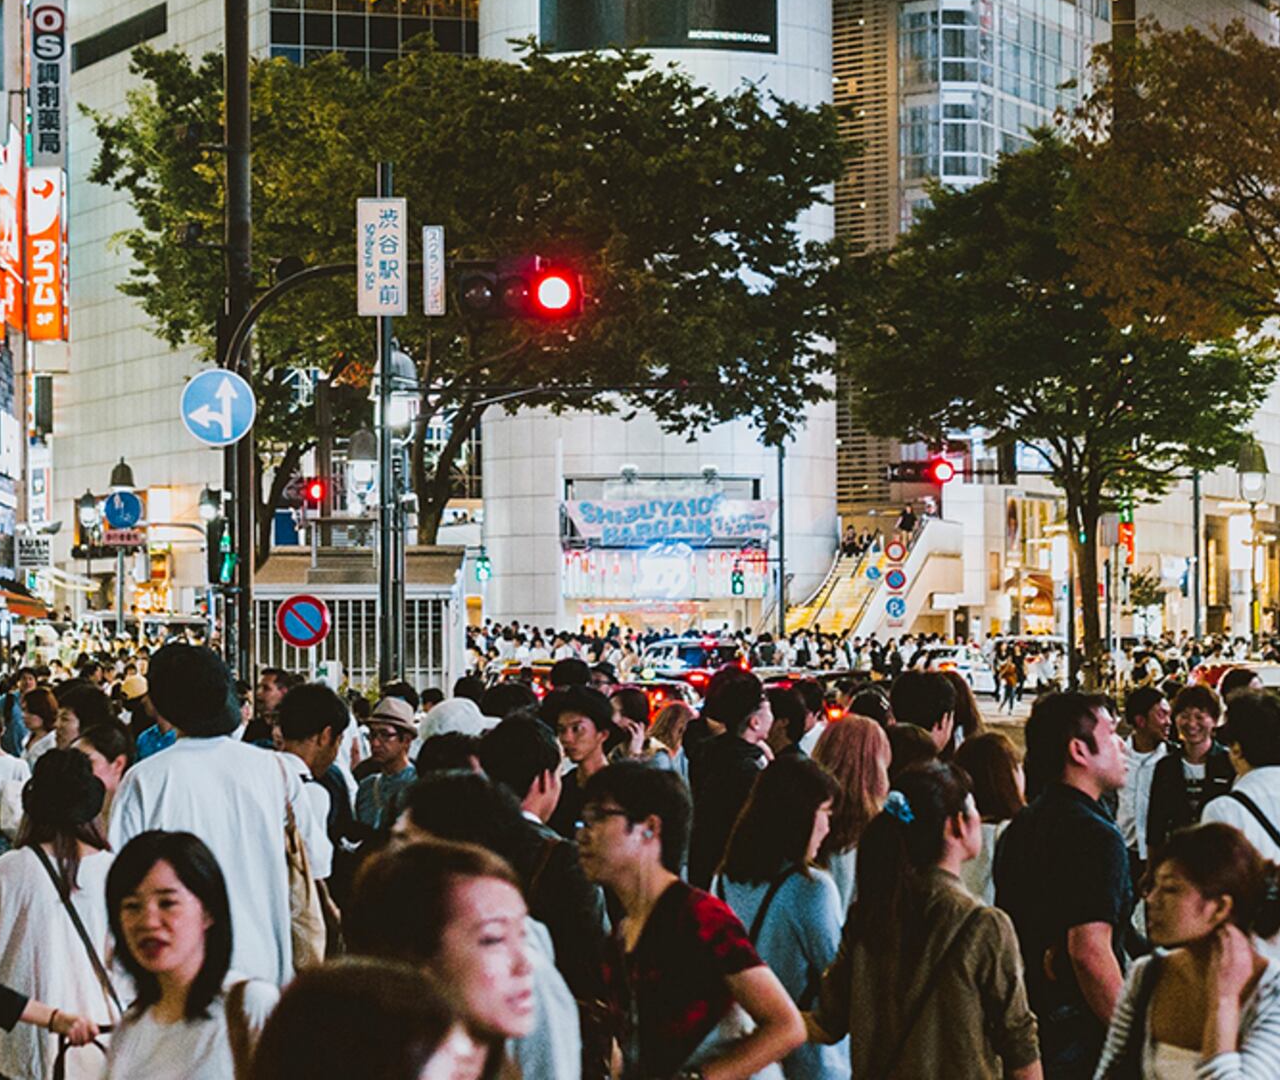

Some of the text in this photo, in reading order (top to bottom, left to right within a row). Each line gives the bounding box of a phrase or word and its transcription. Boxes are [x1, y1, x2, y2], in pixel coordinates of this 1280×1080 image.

[33, 239, 57, 306] アコム
[379, 208, 399, 305] 渋谷駅前
